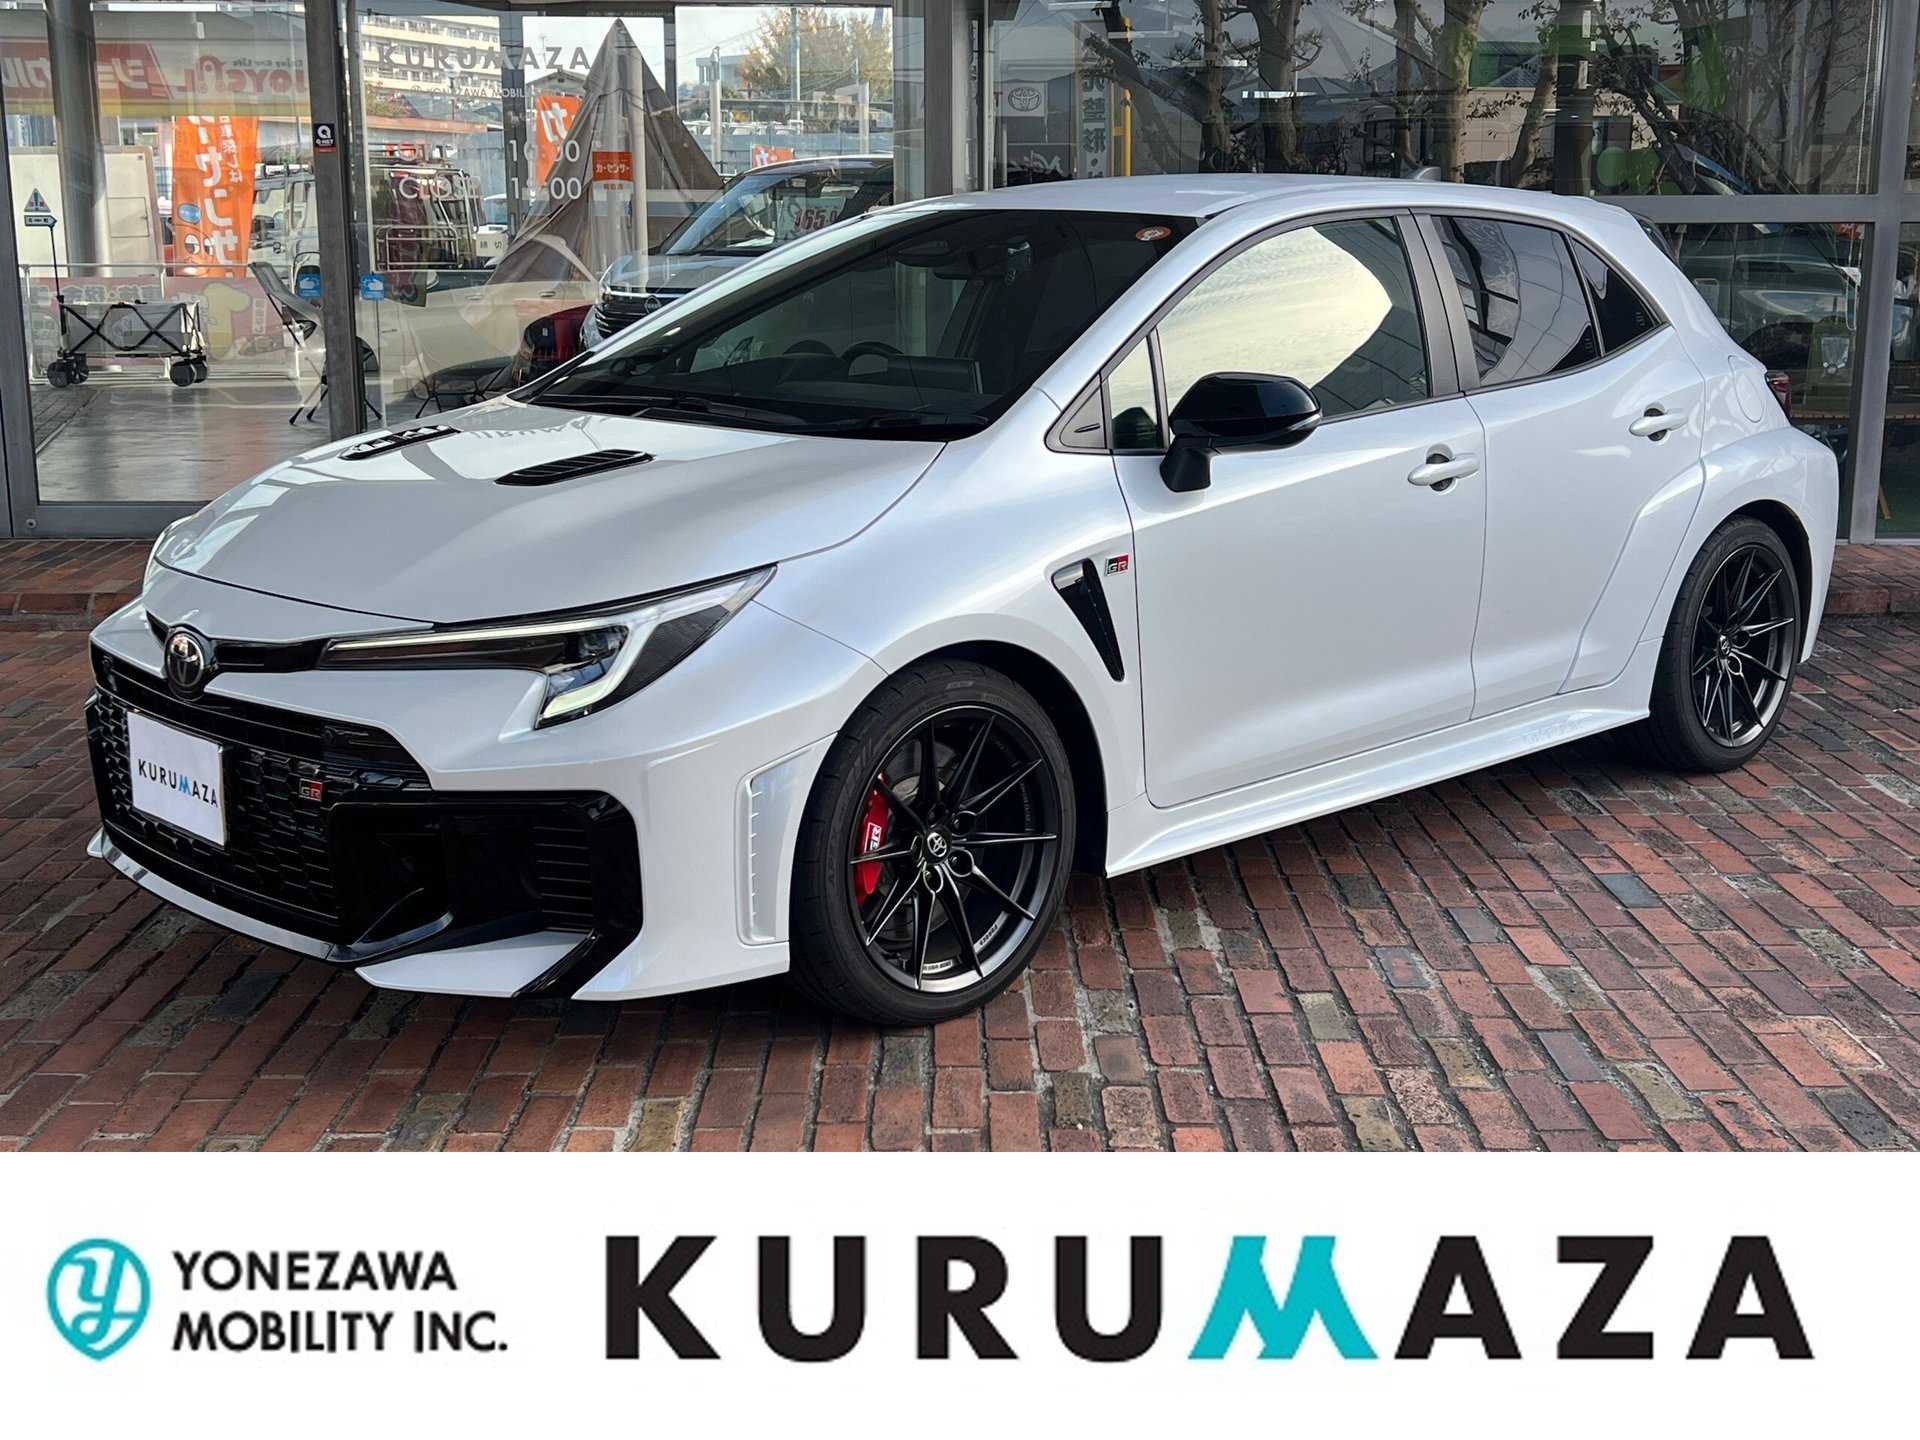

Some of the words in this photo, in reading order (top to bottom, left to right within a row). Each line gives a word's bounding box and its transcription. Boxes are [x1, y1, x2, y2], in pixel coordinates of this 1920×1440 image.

[377, 46, 592, 70] KURUMAZA
[426, 85, 488, 97] YONZAWA
[511, 177, 583, 200] 100
[137, 758, 219, 808] KURUMAZA
[868, 826, 882, 850] GR
